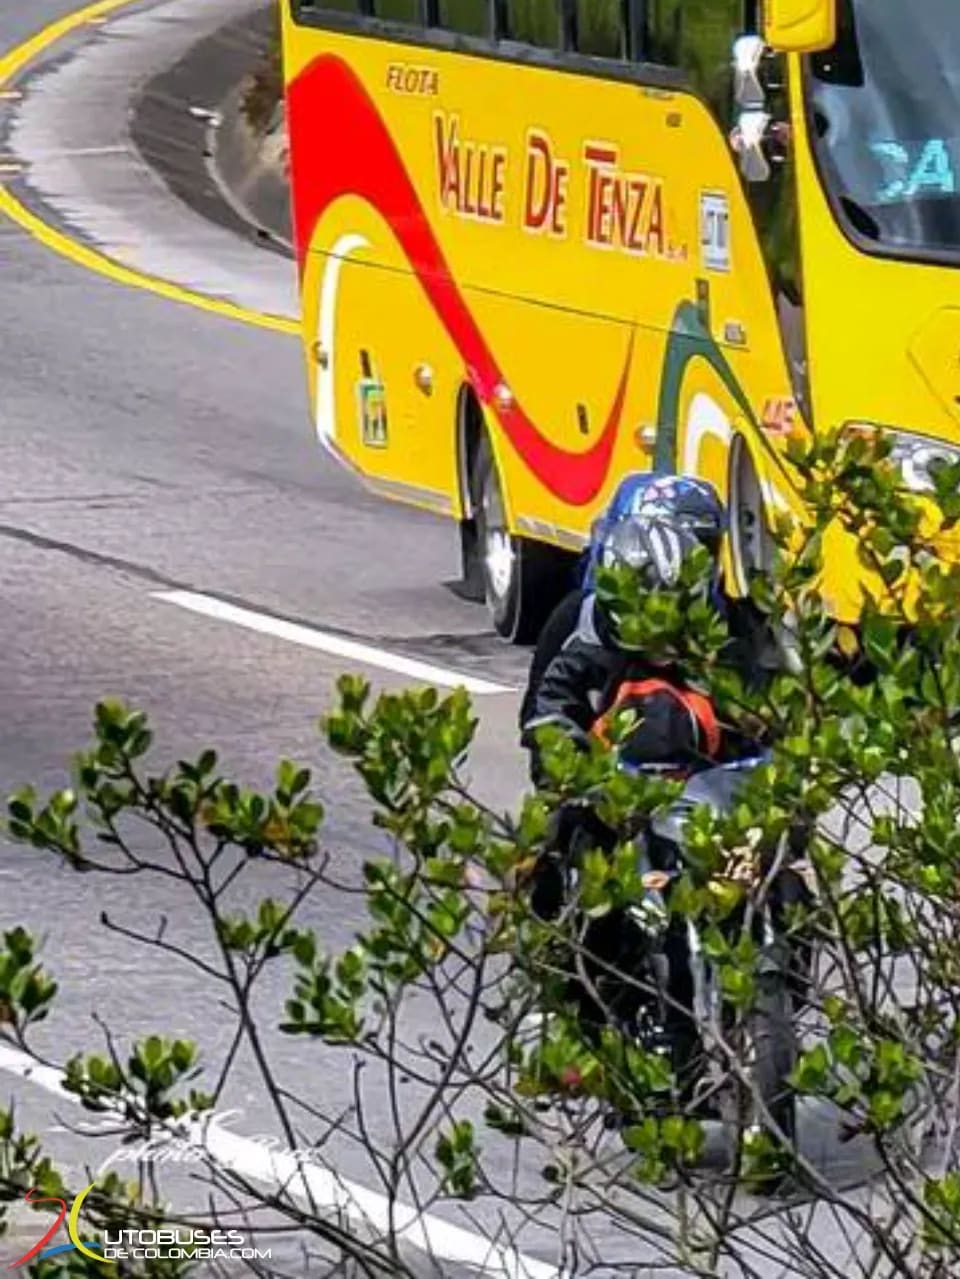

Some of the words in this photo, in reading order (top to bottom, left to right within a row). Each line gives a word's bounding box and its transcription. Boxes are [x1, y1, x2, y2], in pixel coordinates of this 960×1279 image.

[387, 65, 439, 95] FLOTA
[432, 111, 506, 224] VALLE
[522, 127, 569, 236] DE
[583, 140, 665, 257] TENZA
